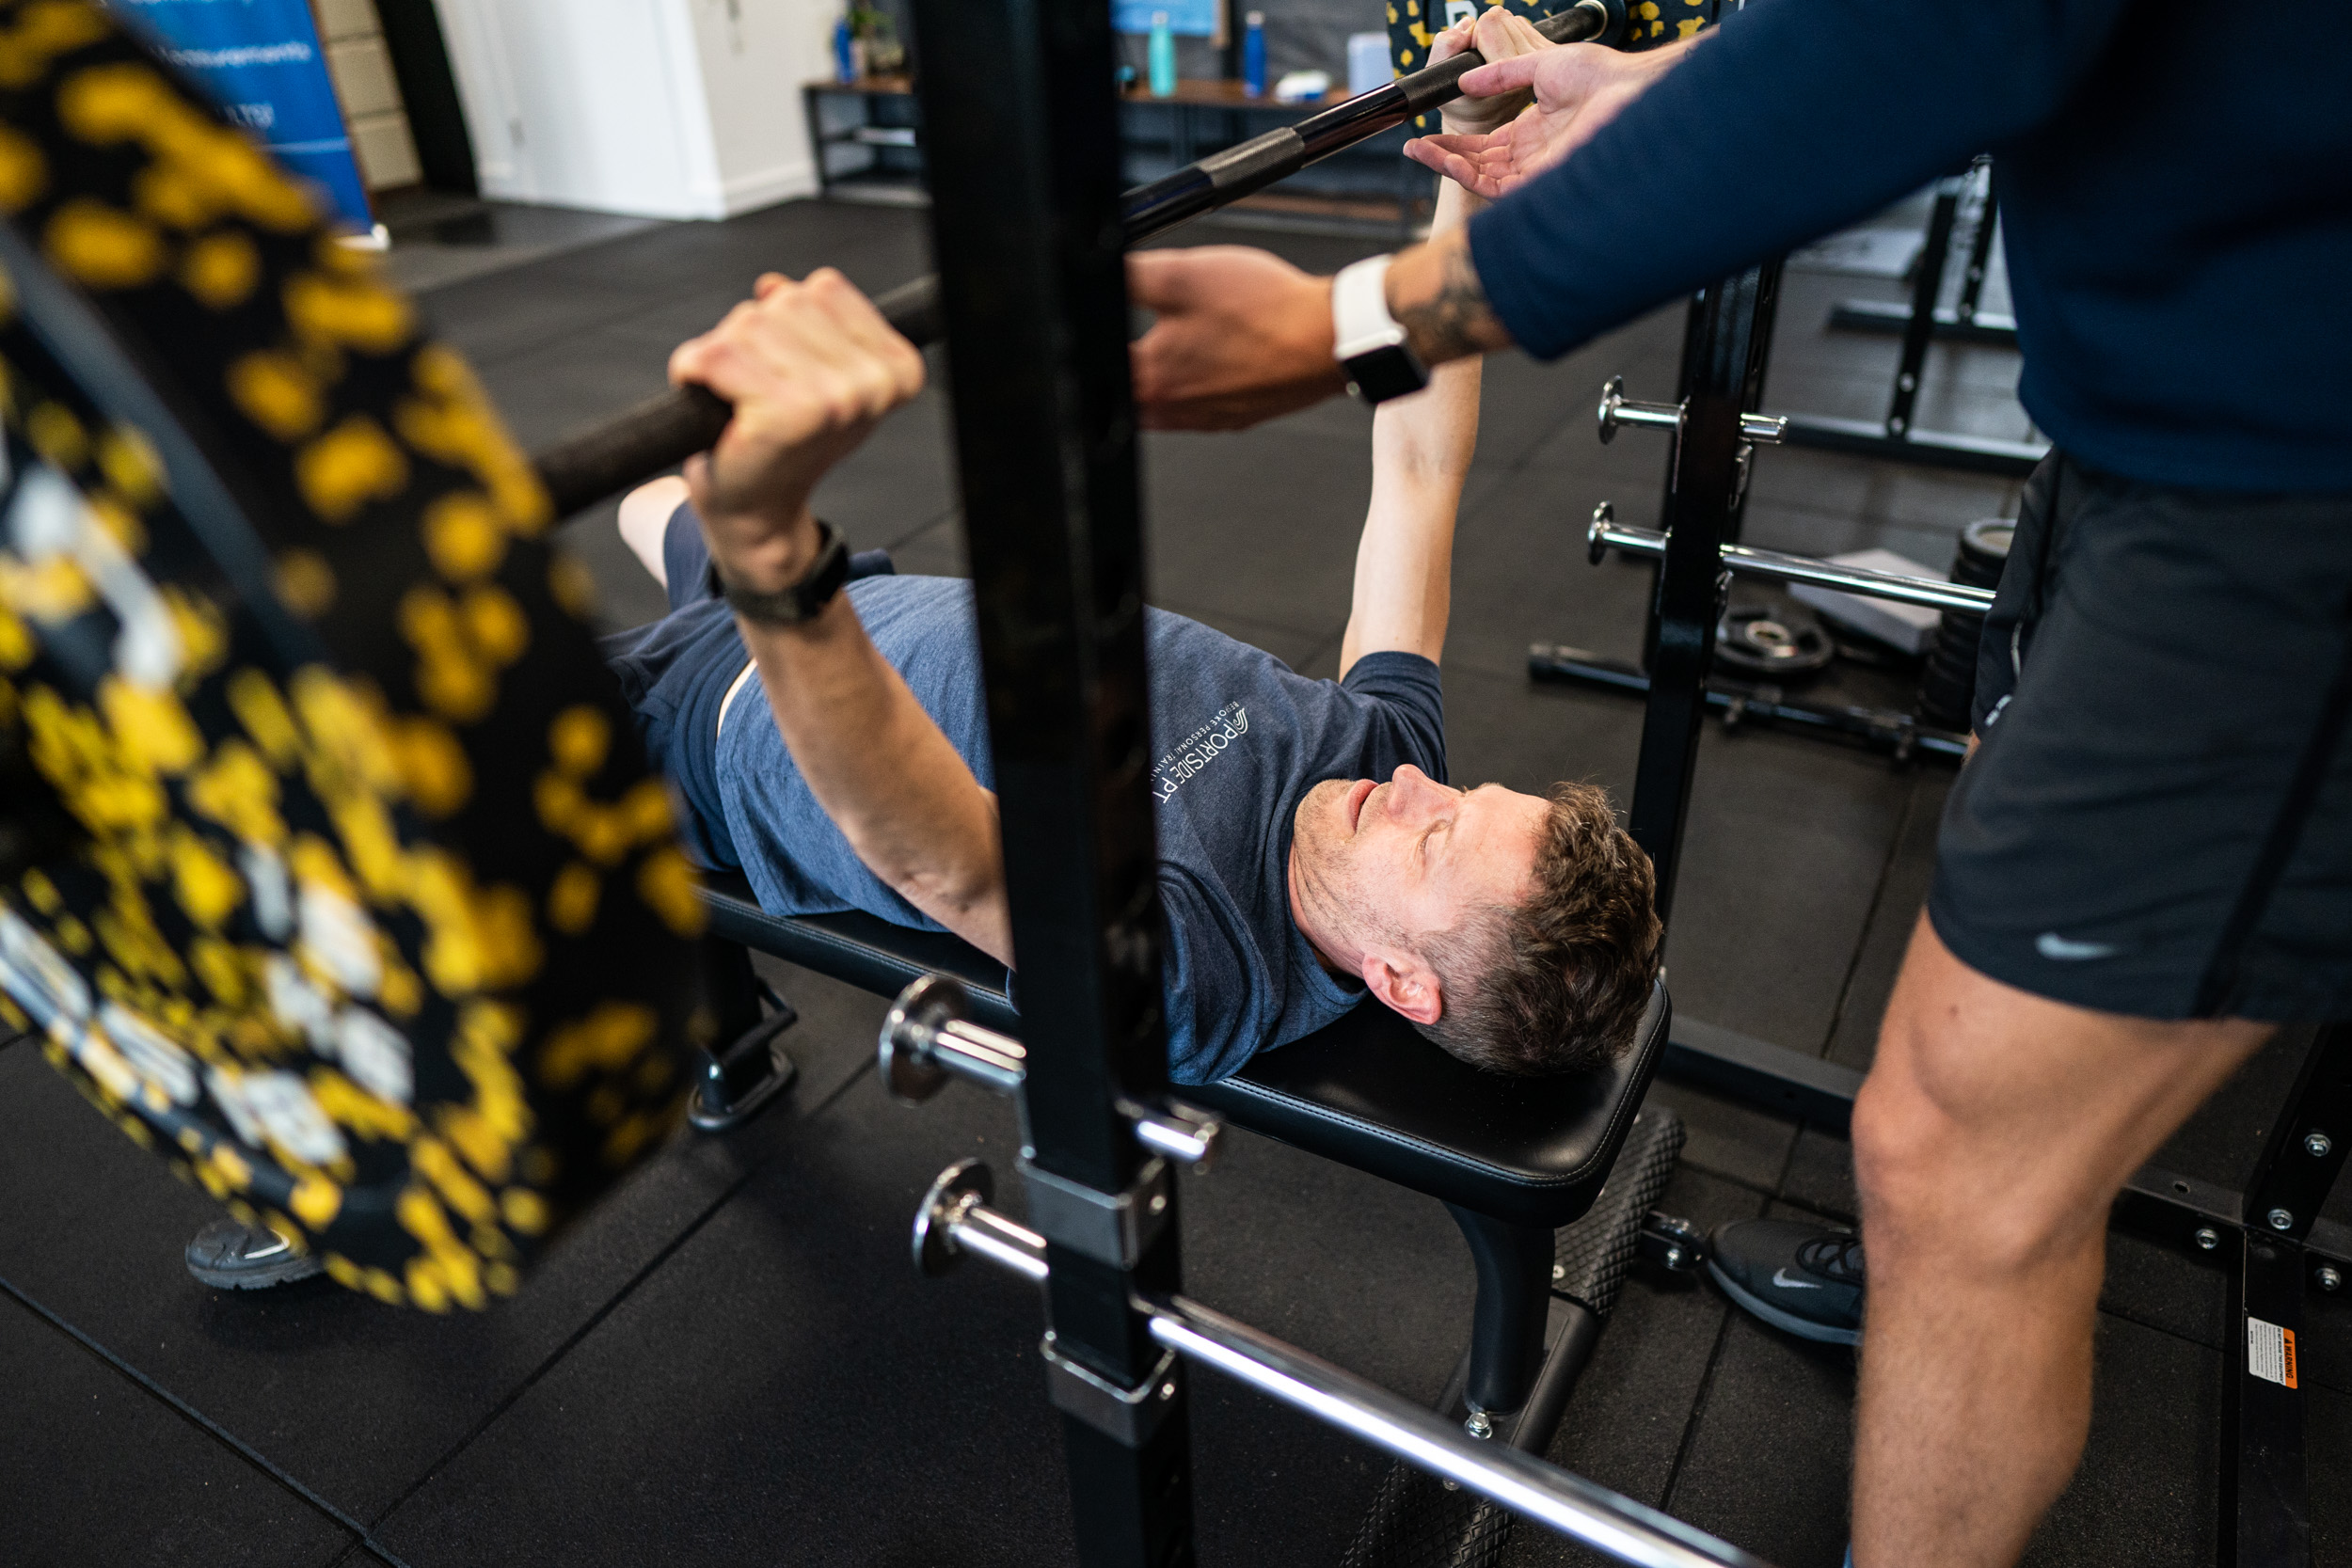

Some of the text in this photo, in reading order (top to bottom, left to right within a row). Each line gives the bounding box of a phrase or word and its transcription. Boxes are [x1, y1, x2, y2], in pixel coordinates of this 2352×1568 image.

[1174, 724, 1212, 755] PERSONAL
[1152, 722, 1239, 804] PORTSIDE PT
[2284, 1345, 2294, 1379] WARNING
